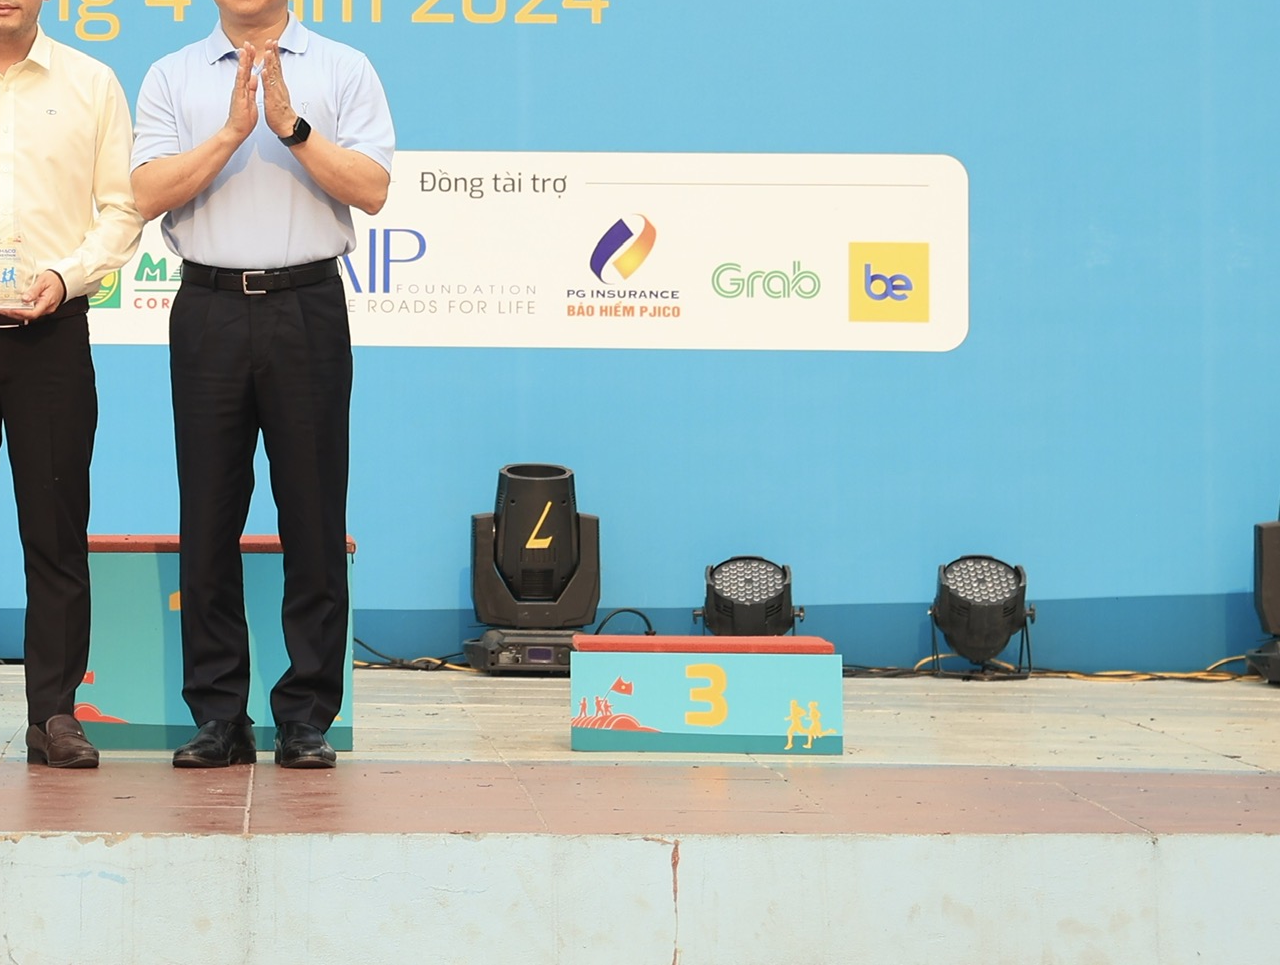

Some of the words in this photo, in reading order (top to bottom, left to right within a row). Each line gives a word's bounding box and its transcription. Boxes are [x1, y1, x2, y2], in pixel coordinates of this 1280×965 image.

[420, 168, 485, 200] Đồng
[492, 171, 523, 194] tài
[532, 174, 568, 199] trợ
[396, 283, 537, 296] FOUNDATION
[712, 261, 822, 301] Grab
[865, 263, 915, 302] be
[567, 289, 587, 300] PG
[591, 289, 680, 301] INSURANCE
[367, 299, 438, 315] ROADS
[448, 300, 488, 315] FOR
[498, 300, 536, 316] LIFE
[639, 305, 682, 319] PJICO
[685, 664, 729, 728] 3
